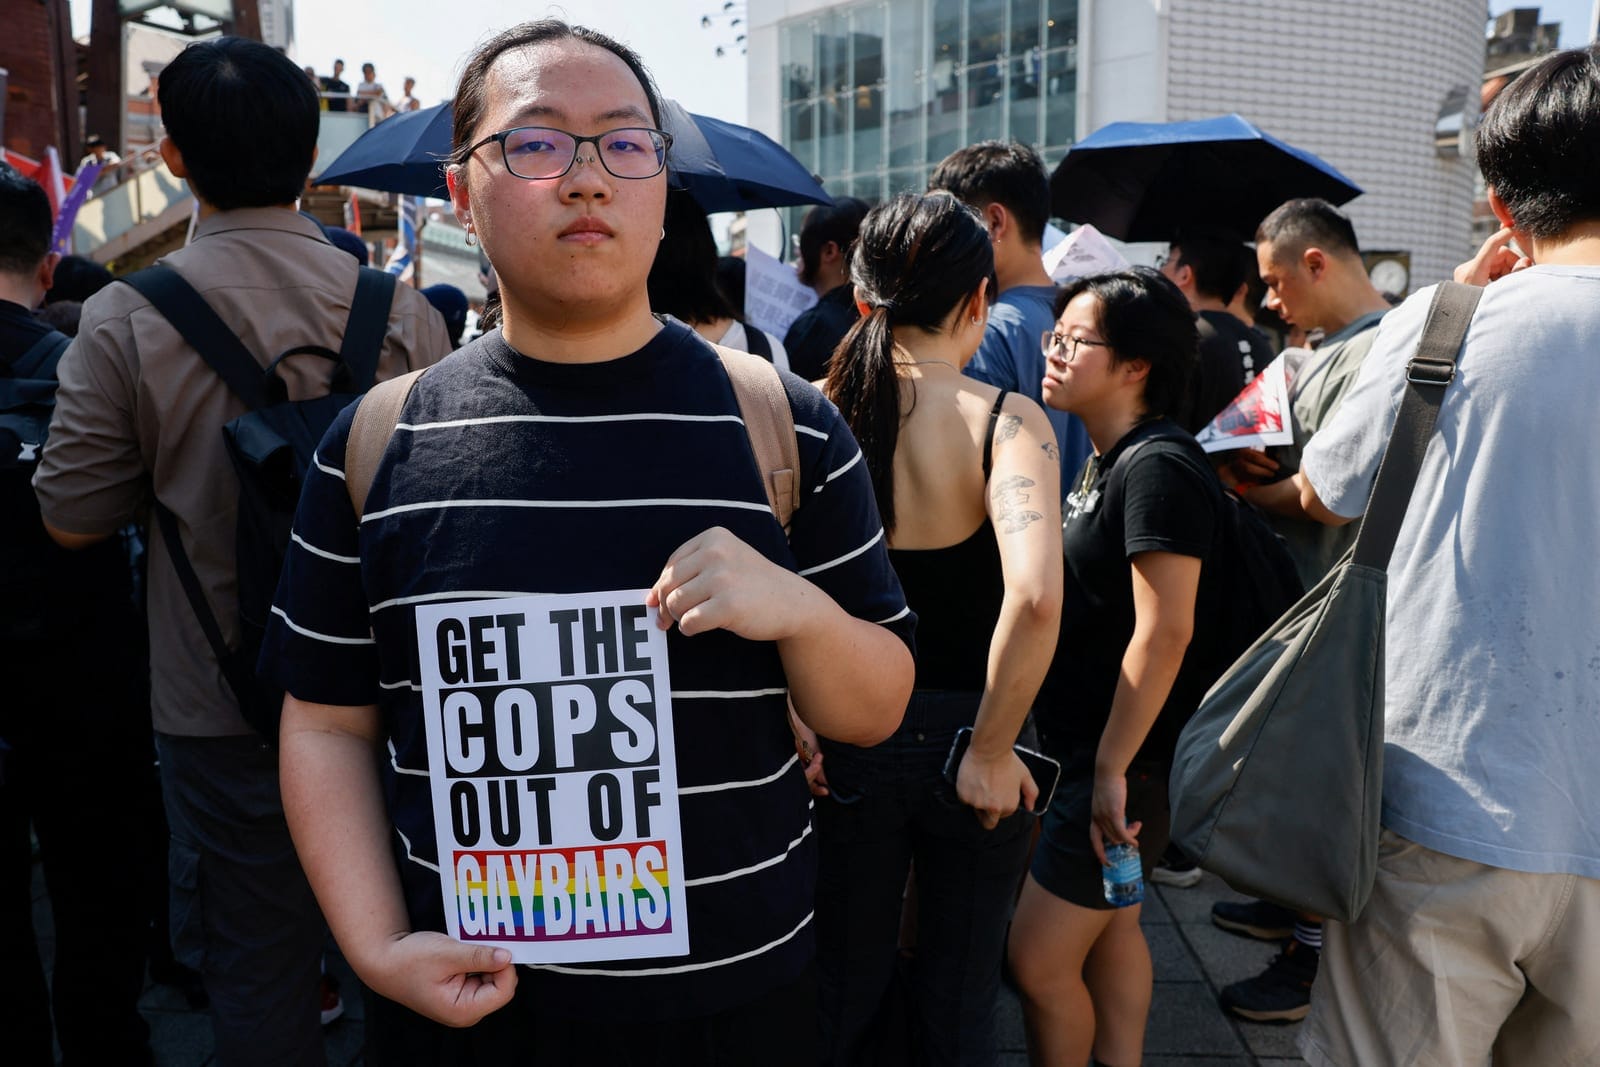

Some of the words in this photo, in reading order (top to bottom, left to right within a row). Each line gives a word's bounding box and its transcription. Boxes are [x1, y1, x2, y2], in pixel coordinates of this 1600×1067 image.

[436, 613, 525, 684] GET
[549, 604, 652, 676] THE
[443, 679, 656, 774] COPS
[450, 777, 556, 847] OUT
[587, 769, 661, 842] OF
